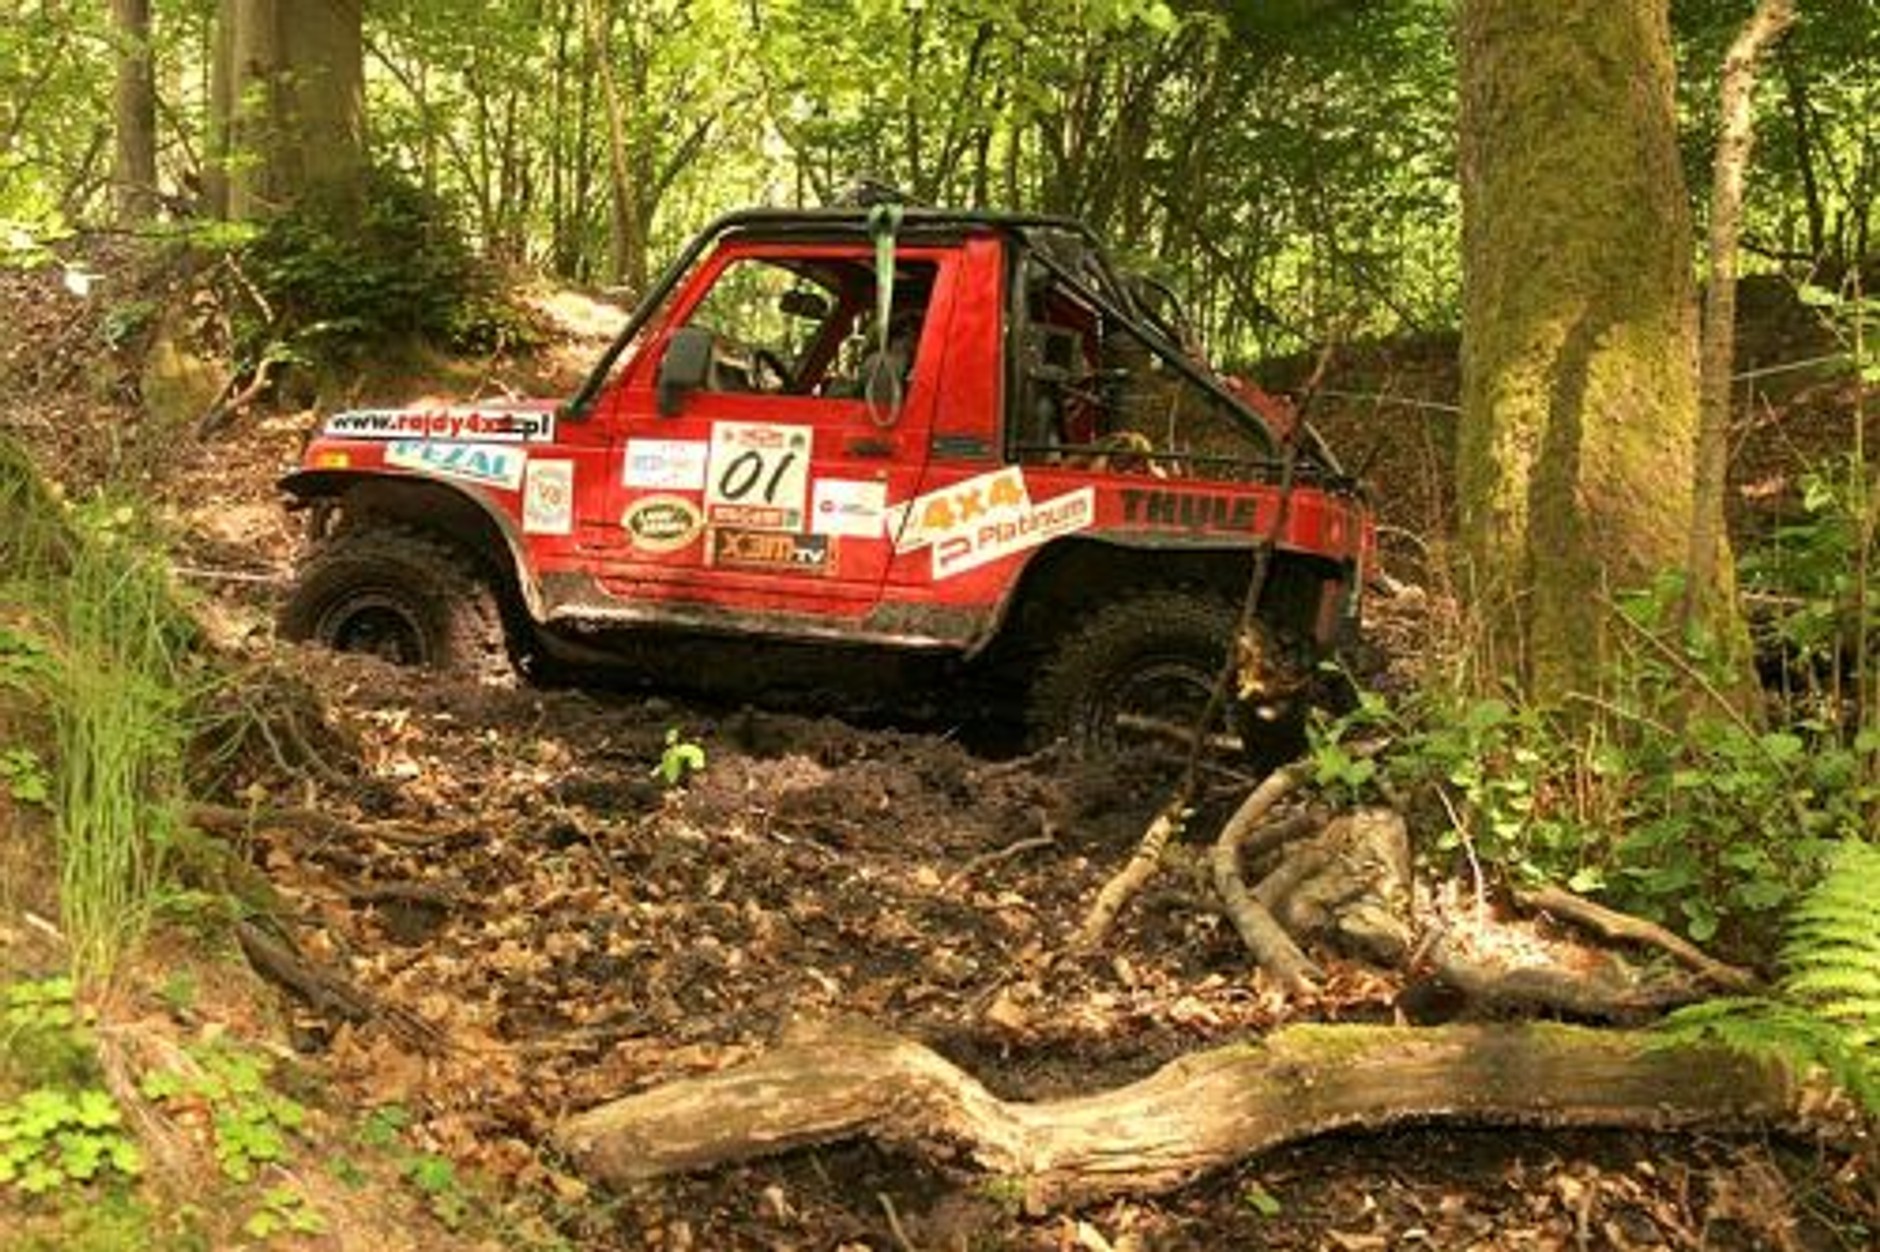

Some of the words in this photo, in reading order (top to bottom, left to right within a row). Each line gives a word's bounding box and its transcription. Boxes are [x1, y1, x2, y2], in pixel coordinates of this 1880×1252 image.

[719, 450, 796, 504] 01
[977, 497, 1088, 550] Platinum
[1120, 489, 1257, 531] THULE
